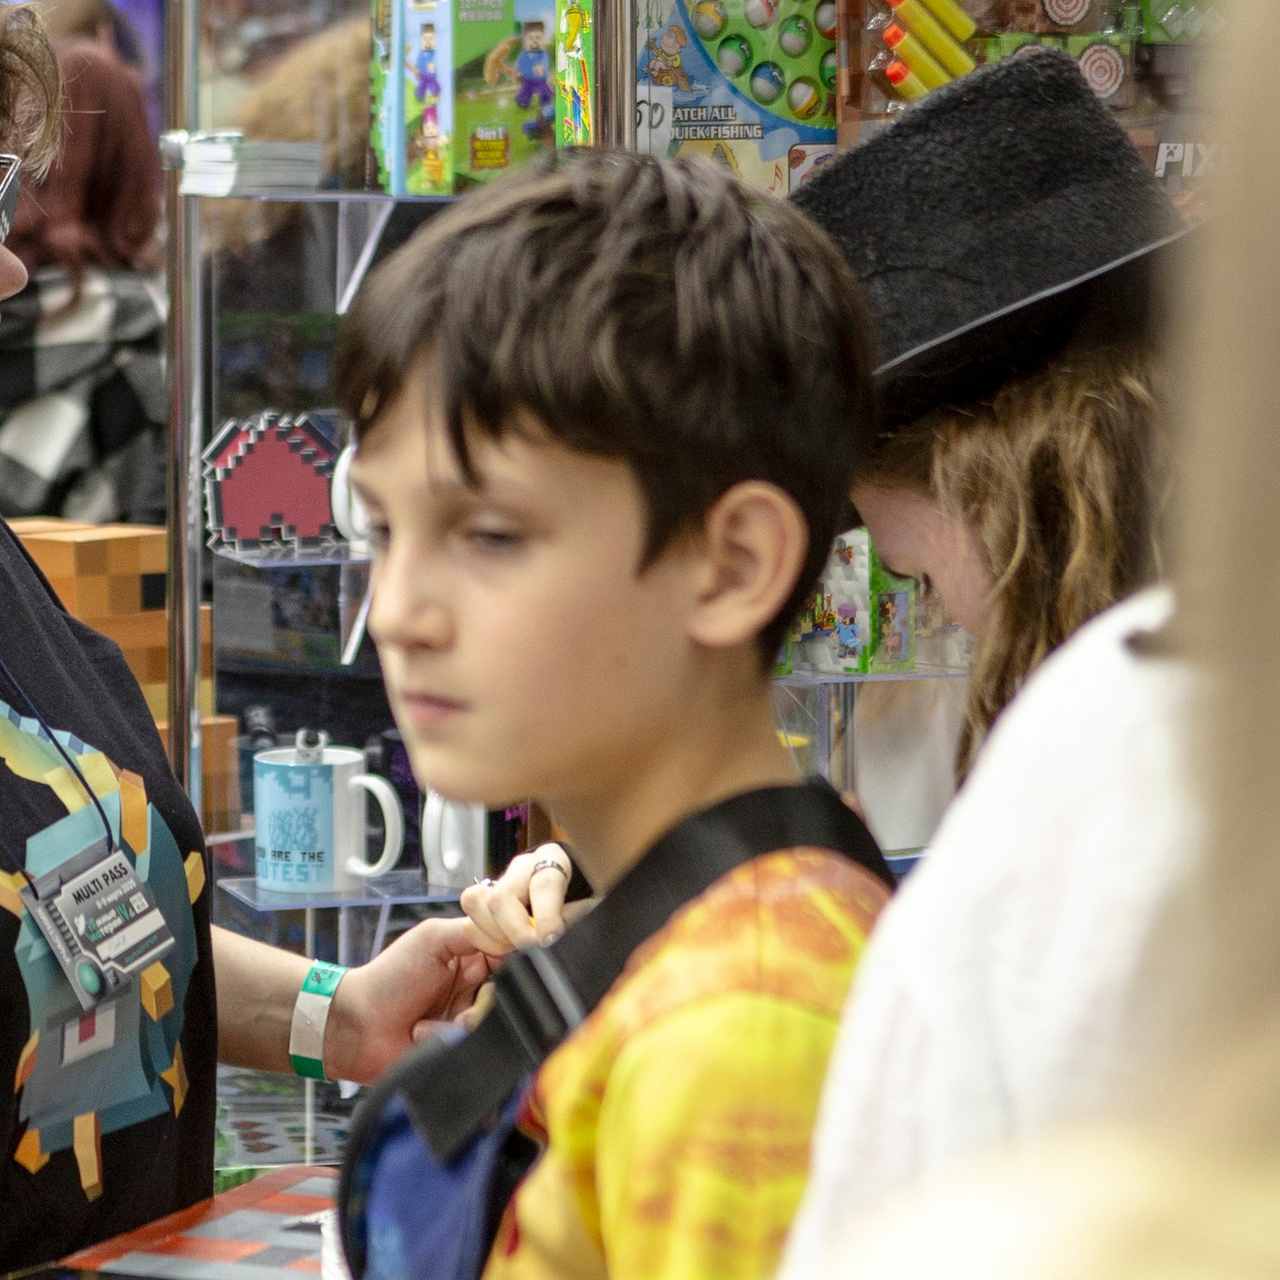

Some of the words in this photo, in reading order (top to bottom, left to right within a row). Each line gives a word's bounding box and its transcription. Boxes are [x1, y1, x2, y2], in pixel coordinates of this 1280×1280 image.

[672, 107, 707, 121] ATCH
[711, 106, 736, 120] ALL
[710, 125, 763, 138] FISHING
[271, 850, 291, 862] ARE
[301, 851, 324, 862] THE
[259, 862, 324, 882] UTEST
[72, 878, 104, 906] MULTI
[104, 862, 128, 887] PASS
